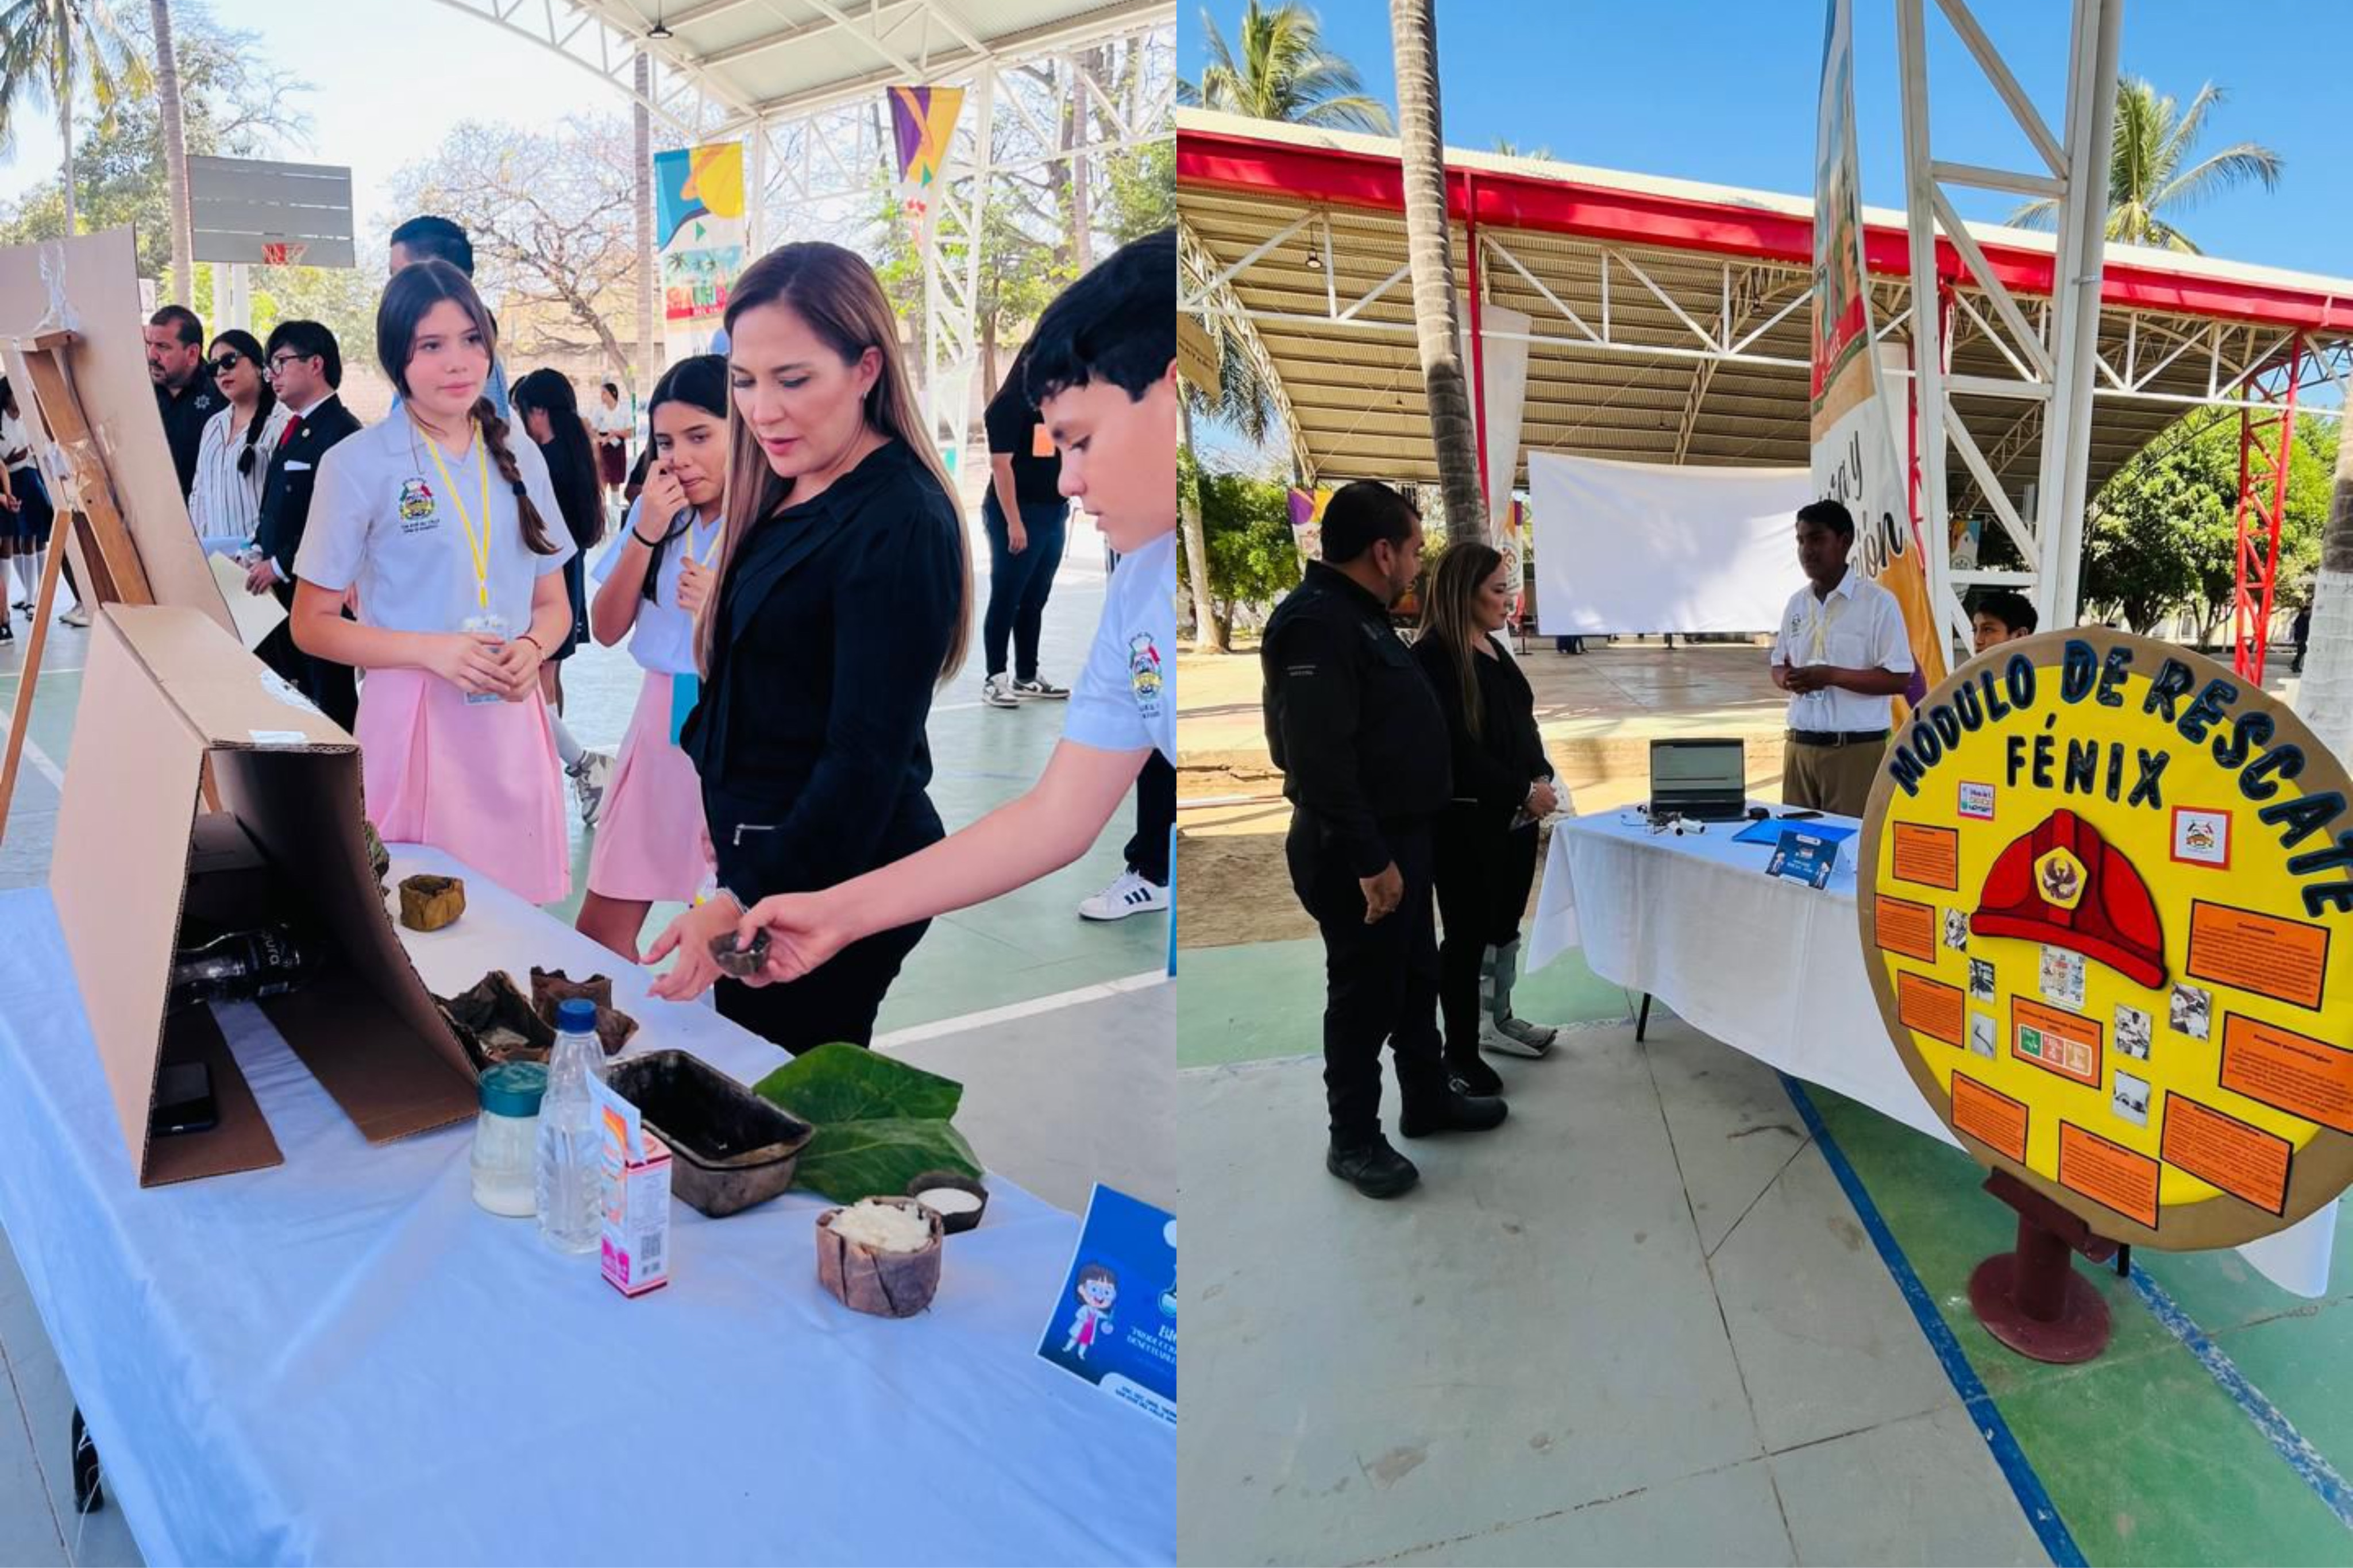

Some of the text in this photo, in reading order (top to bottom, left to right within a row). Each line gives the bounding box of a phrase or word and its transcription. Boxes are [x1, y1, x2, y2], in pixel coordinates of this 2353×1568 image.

[1889, 654, 2038, 797] MÓDULO
[2060, 639, 2134, 708] DE
[2005, 712, 2170, 810] FÉNIX
